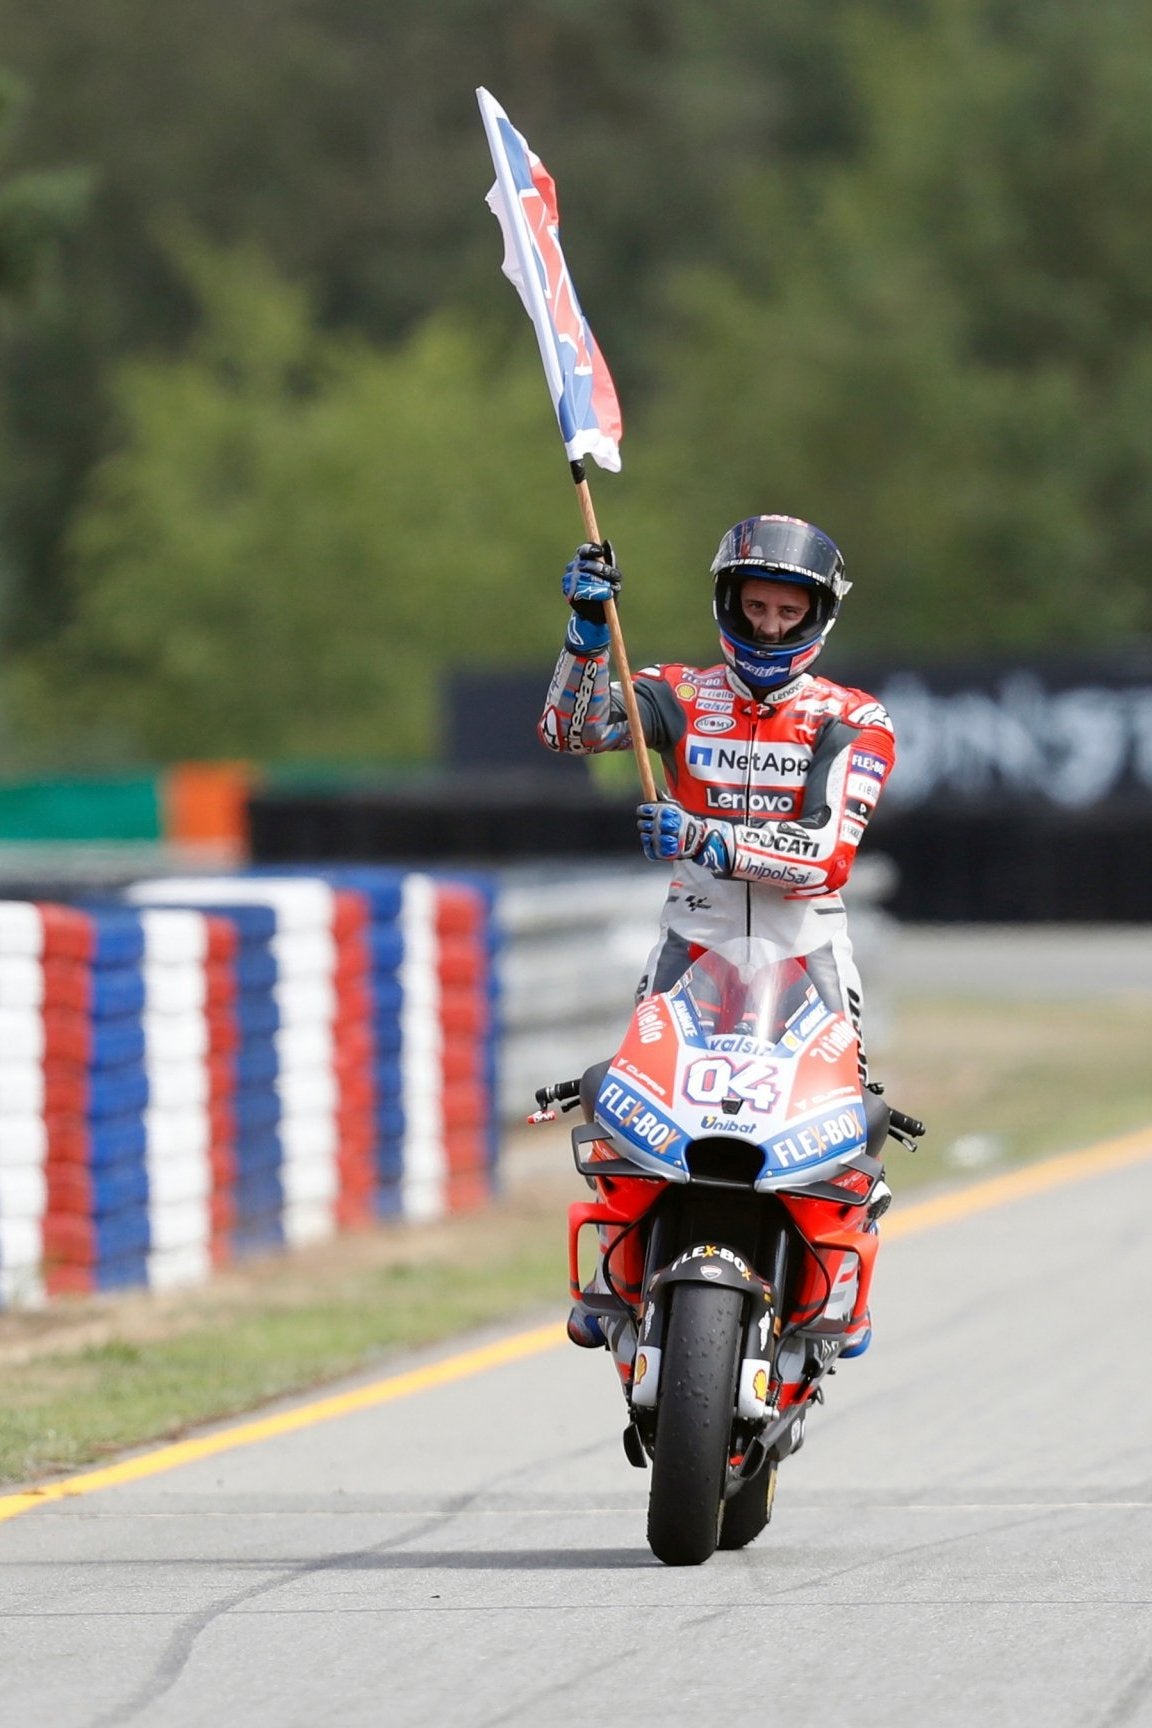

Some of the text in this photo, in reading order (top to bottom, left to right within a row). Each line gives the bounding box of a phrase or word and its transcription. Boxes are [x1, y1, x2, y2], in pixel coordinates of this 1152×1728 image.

[697, 701, 732, 712] valsir
[717, 748, 812, 777] NetApp
[706, 787, 794, 813] Lenovo
[743, 829, 821, 858] DUCATI
[736, 852, 812, 886] UnipolSai
[682, 1055, 782, 1115] 04
[598, 1081, 683, 1155] FLEX-BOX
[700, 1115, 758, 1135] Unibat
[772, 1107, 865, 1169] FLEX-BOX
[671, 1244, 752, 1282] FLEX-BOX
